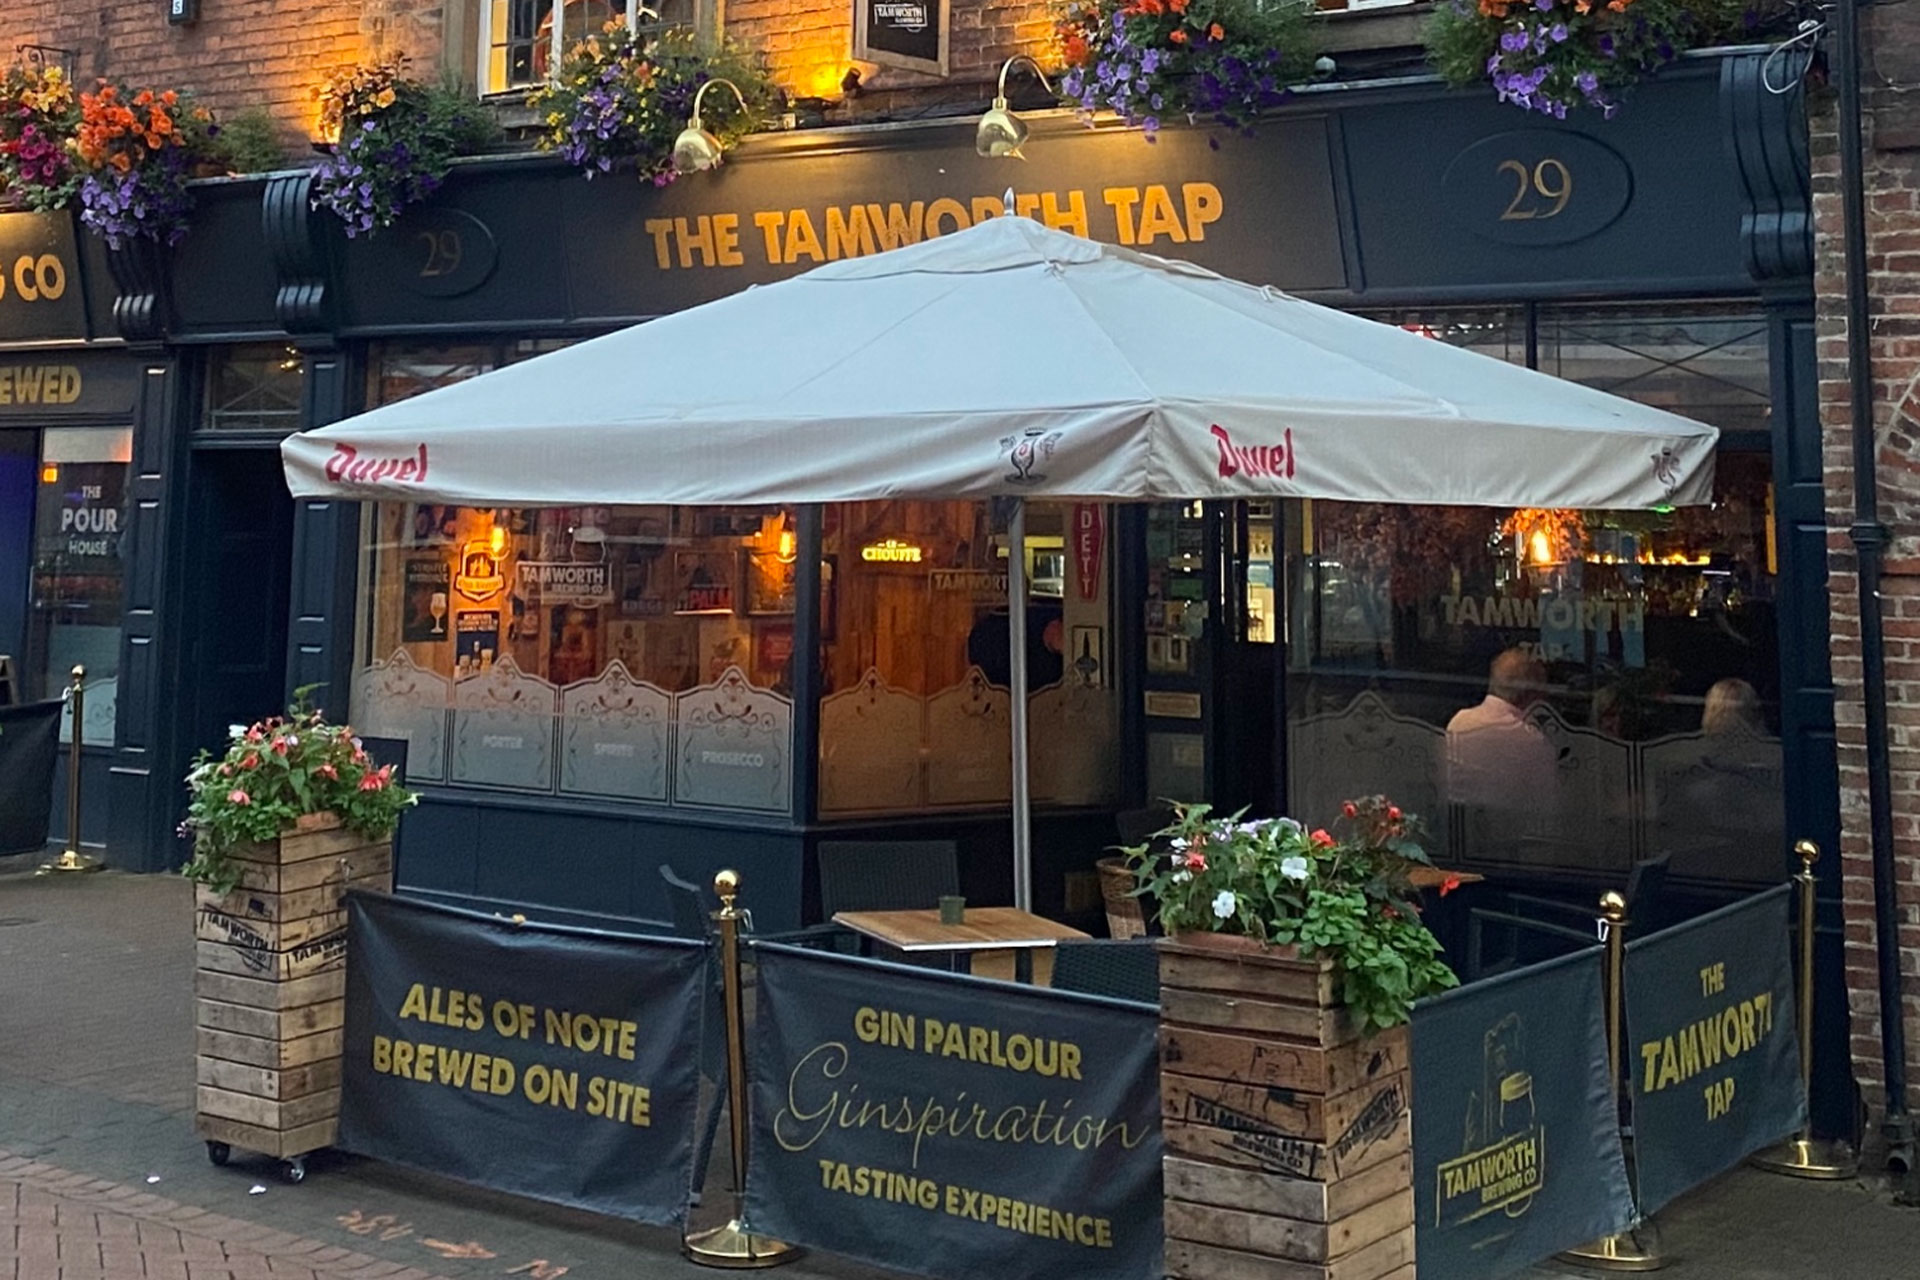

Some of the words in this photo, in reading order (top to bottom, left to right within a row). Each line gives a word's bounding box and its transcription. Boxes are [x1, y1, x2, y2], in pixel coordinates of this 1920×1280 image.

[1498, 159, 1571, 220] 29
[645, 213, 744, 269] THE
[1103, 183, 1223, 245] TAP
[417, 230, 462, 277] 29
[14, 254, 66, 301] CO
[326, 443, 427, 482] Duvel
[1211, 424, 1294, 479] Duvel
[82, 486, 101, 498] THE
[62, 508, 117, 532] POUR
[69, 541, 107, 555] HOUSE
[1081, 510, 1093, 594] DETT
[522, 566, 604, 584] TAMWORTH
[935, 574, 1008, 590] TAMWORT
[1440, 595, 1645, 631] TAMWORTH
[702, 750, 764, 767] PROSECCO
[1700, 962, 1725, 997] THE
[399, 983, 485, 1031] ALES
[492, 1000, 536, 1040] OF
[544, 1008, 638, 1060] NOTE
[854, 1006, 915, 1050] GIN
[924, 1019, 1082, 1081] PARLOUR
[372, 1035, 516, 1096] BREWED
[523, 1064, 579, 1111] ON
[586, 1076, 651, 1127] SITE
[1704, 1077, 1735, 1121] TAP
[774, 1042, 1151, 1169] Ginspiration
[1444, 1138, 1536, 1199] TAMWORTH
[1482, 1173, 1523, 1203] BREWING
[819, 1159, 939, 1209] TASTING
[946, 1186, 1113, 1248] EXPERIENCE
